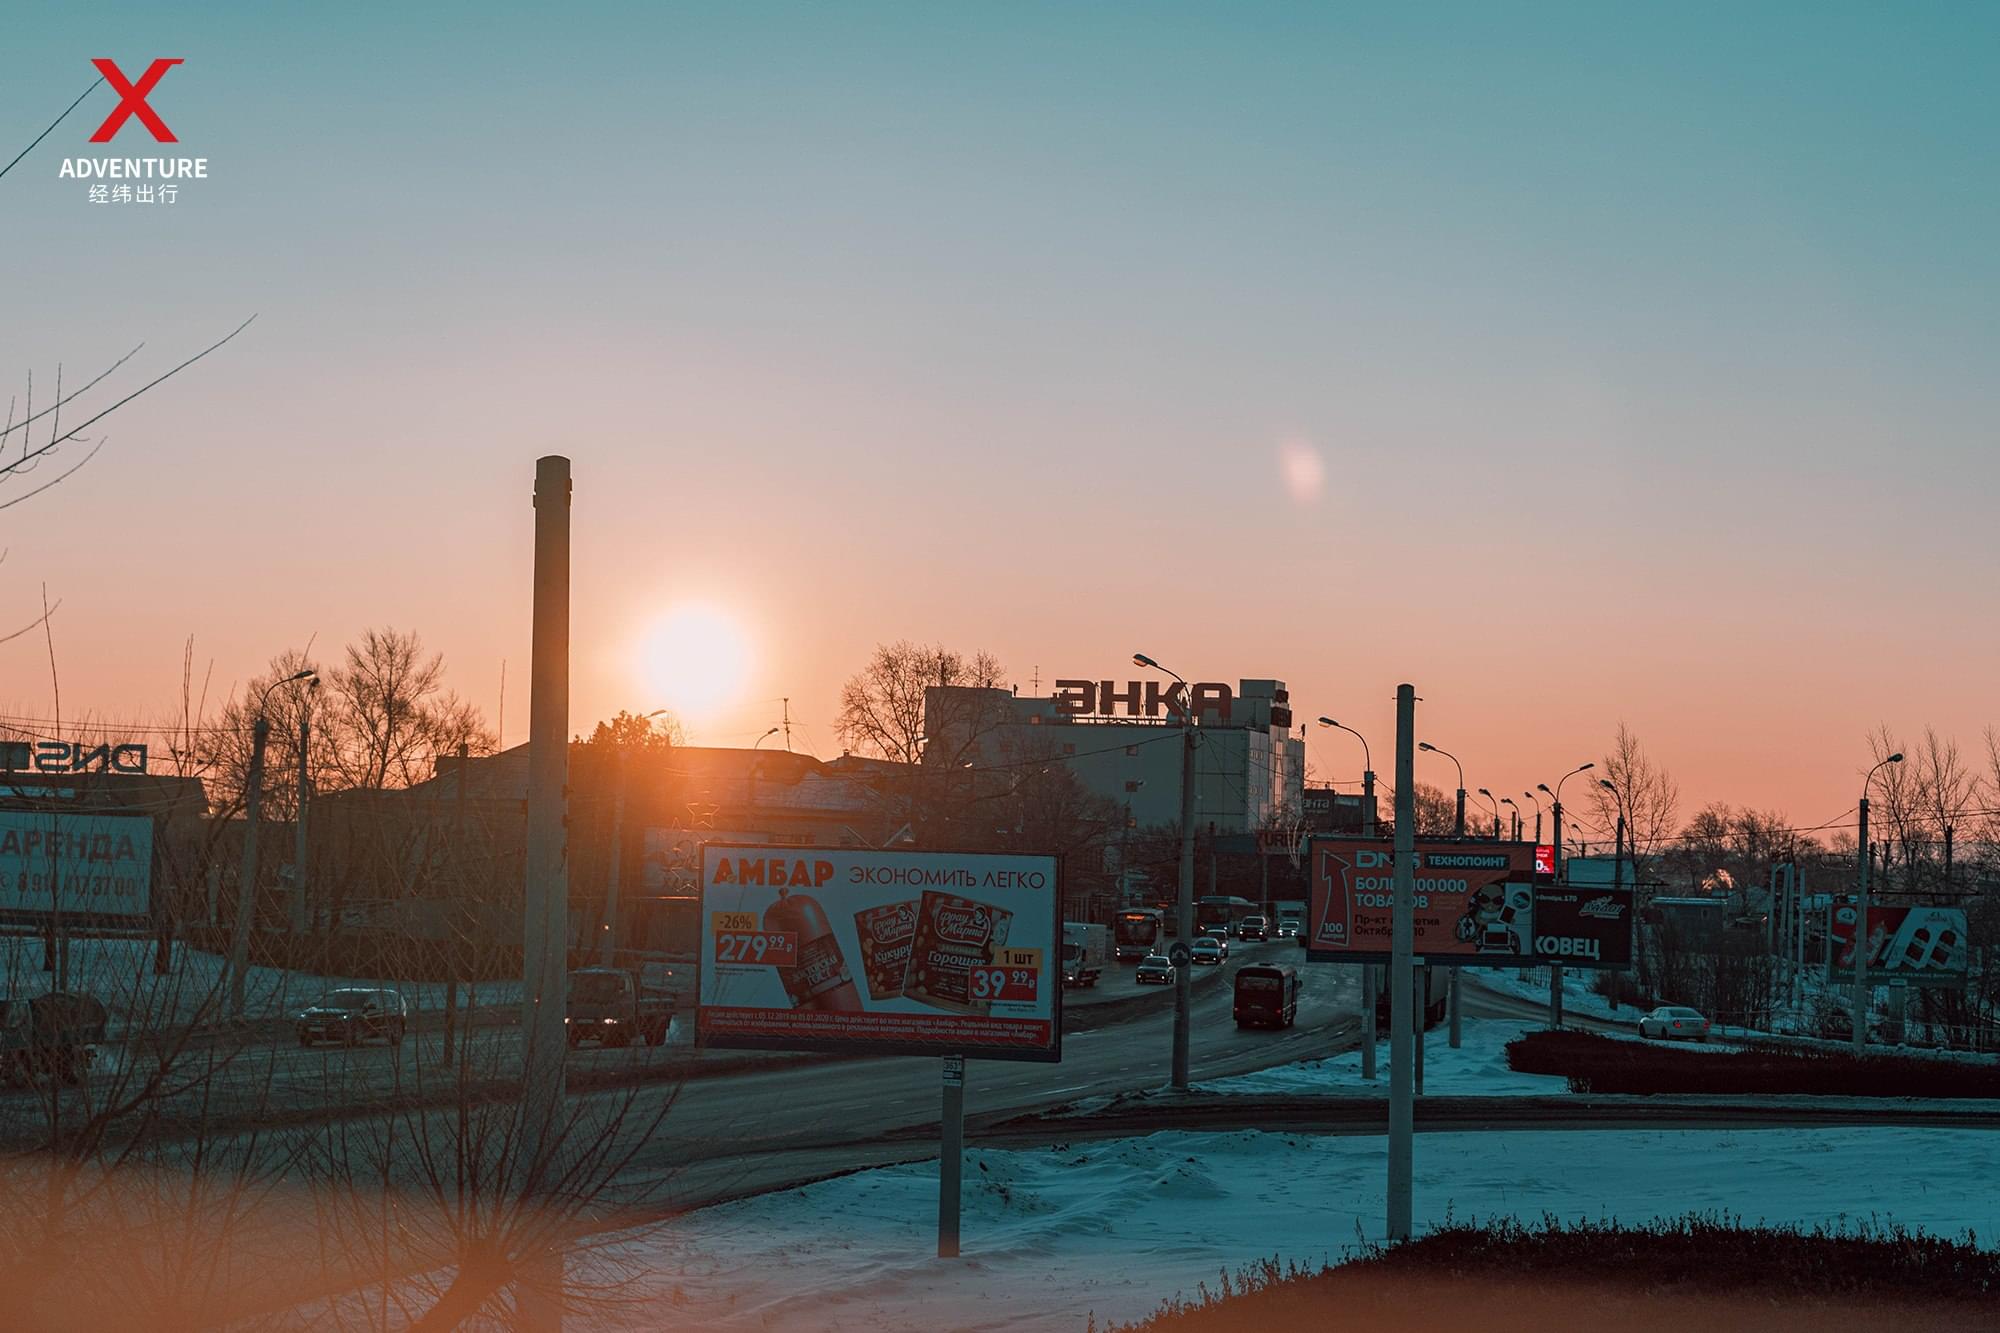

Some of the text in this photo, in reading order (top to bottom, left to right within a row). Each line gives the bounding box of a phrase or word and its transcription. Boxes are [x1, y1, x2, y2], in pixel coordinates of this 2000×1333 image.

[0, 830, 136, 864] АРЕНДА
[1428, 855, 1506, 867] ТЕХНОПОИНТ
[712, 858, 1046, 889] АМБАР ЭКОНОМИТЬ ЛЕГКО
[719, 915, 752, 930] -26%
[1324, 922, 1344, 934] 100
[719, 935, 768, 961] 279
[768, 936, 785, 948] 99
[1003, 950, 1034, 966] 1 шт
[973, 970, 1006, 998] 39
[1011, 971, 1028, 984] 99
